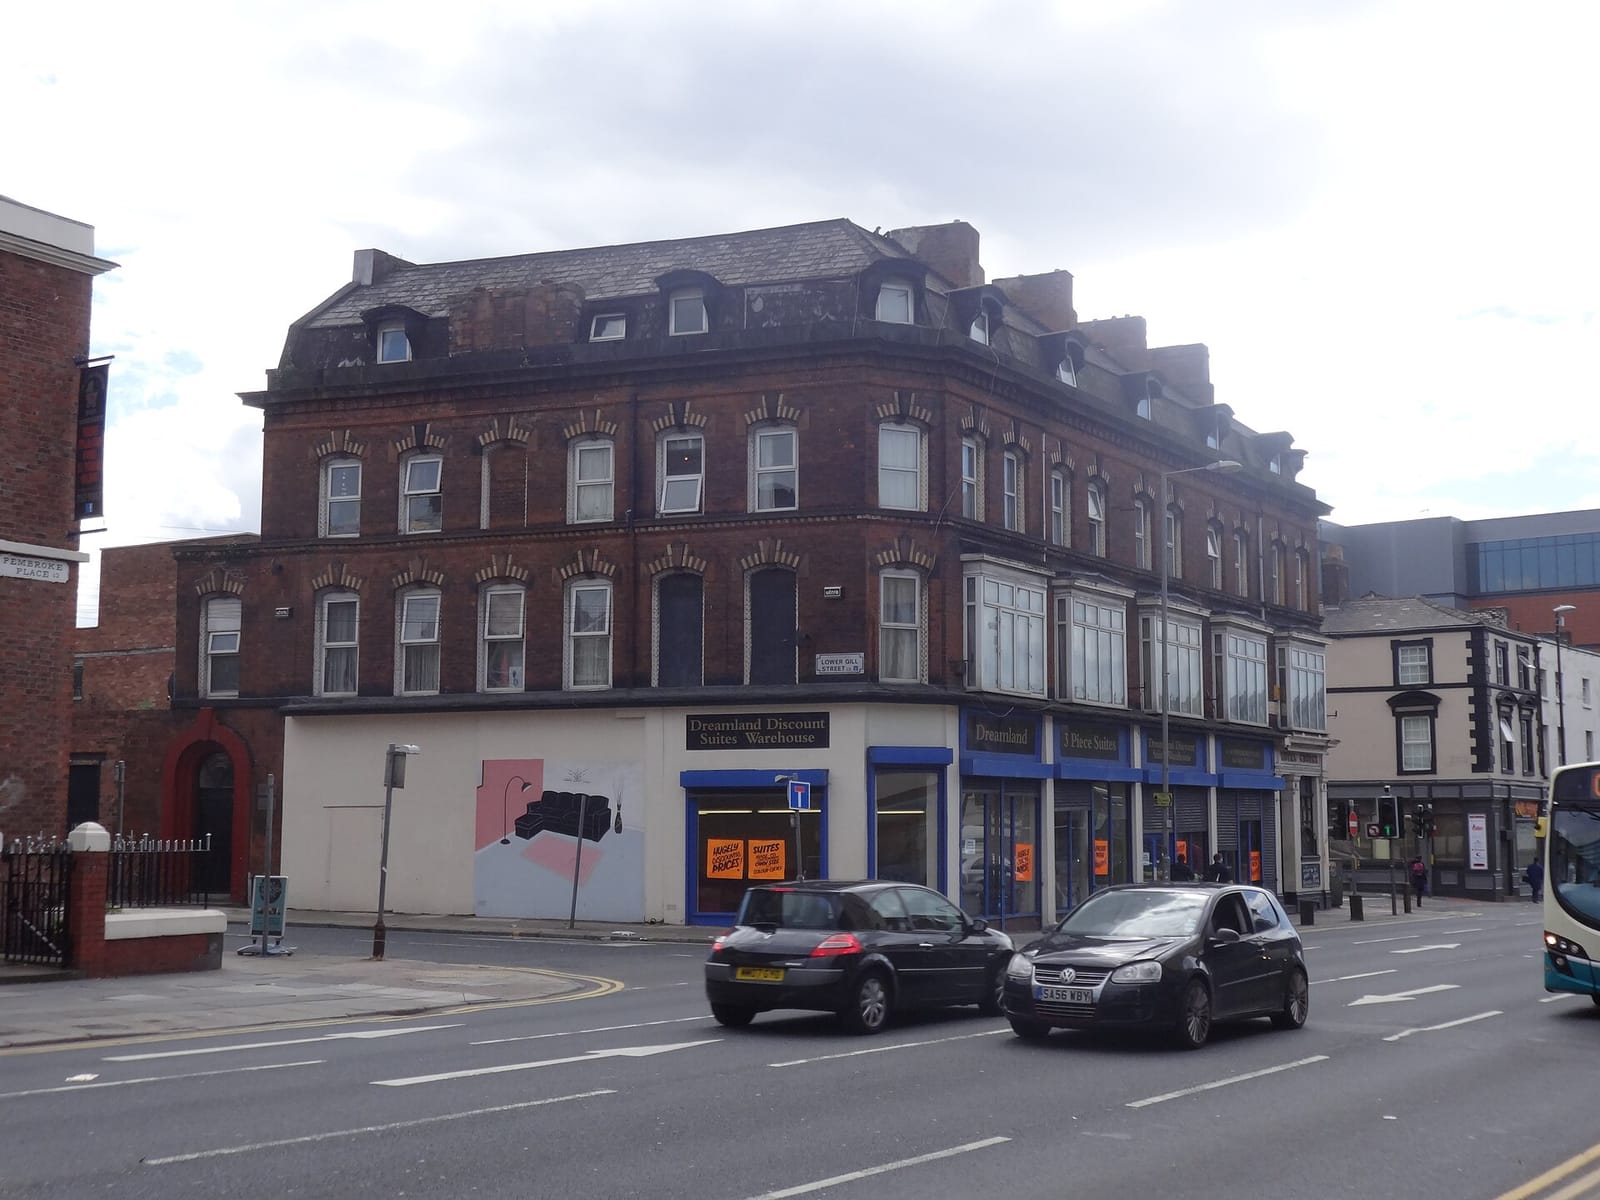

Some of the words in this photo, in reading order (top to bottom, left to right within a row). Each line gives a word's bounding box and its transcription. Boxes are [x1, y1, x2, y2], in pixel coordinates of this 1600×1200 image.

[3, 557, 63, 571] PEMBROKE
[16, 568, 49, 578] PLACE
[691, 718, 761, 731] Dreamland
[767, 718, 825, 730] Discount
[700, 732, 737, 745] Suites
[746, 731, 815, 744] Warehouse
[976, 724, 1028, 744] Dreamland
[1064, 732, 1069, 747] 3
[1071, 732, 1093, 748] Piece
[1094, 736, 1117, 750] Suites
[753, 843, 780, 854] SUITES
[1043, 988, 1067, 999] SA56
[1070, 991, 1089, 1001] WBY
